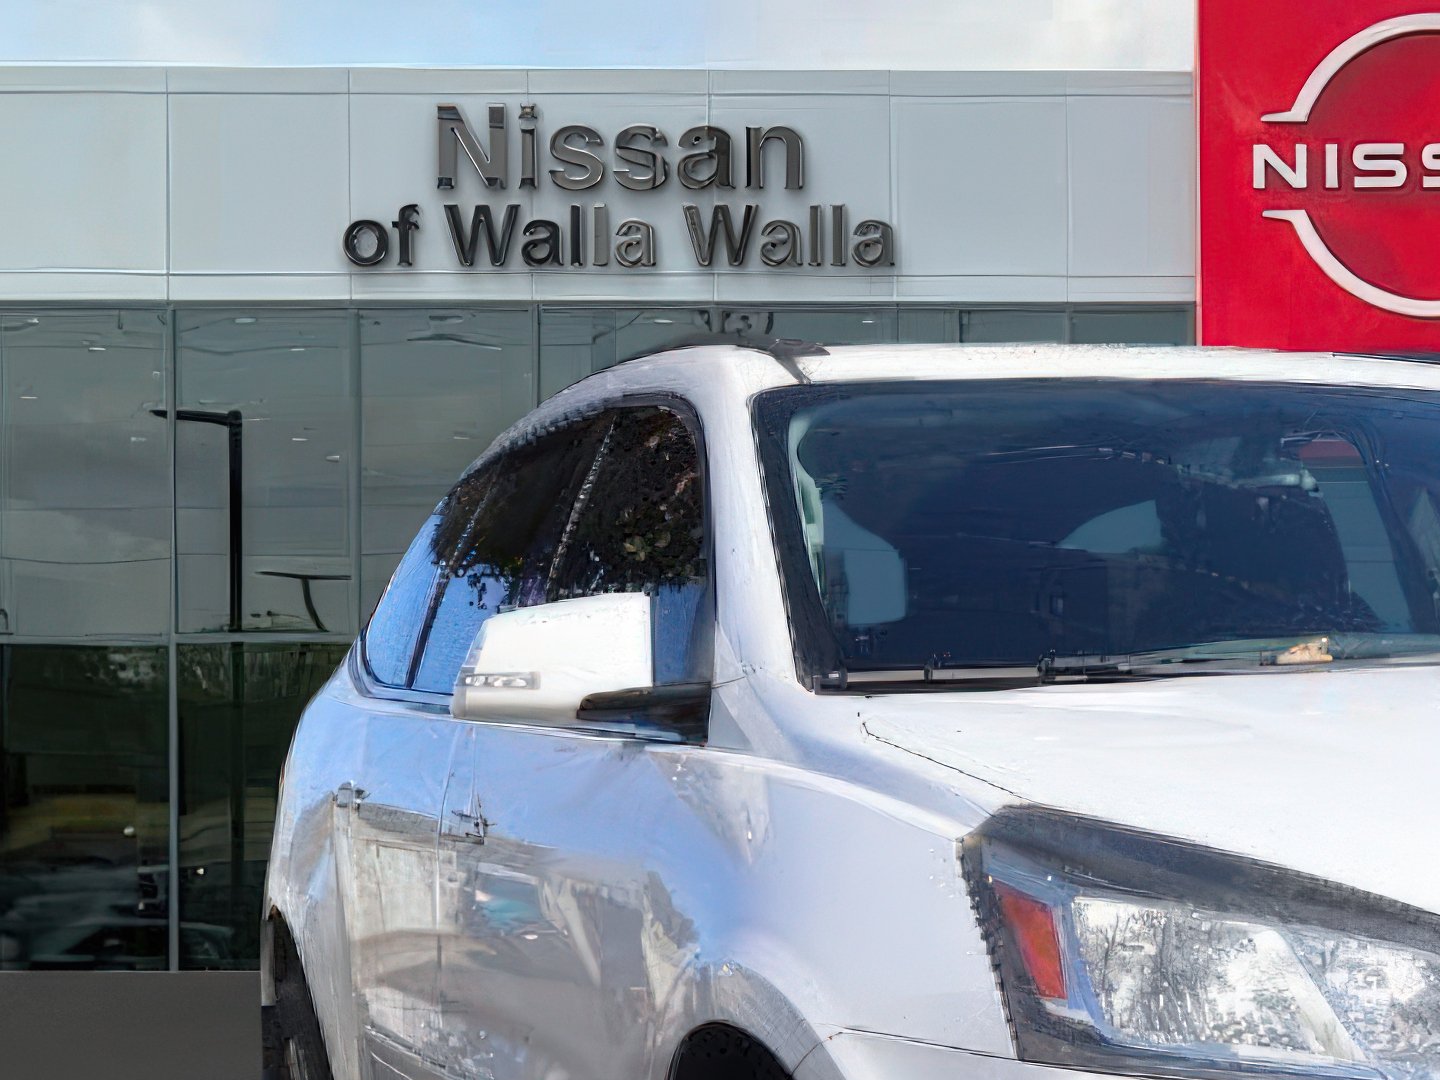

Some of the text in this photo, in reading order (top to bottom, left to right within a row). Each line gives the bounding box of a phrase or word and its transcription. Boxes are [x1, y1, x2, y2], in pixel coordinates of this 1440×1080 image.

[436, 102, 805, 191] Nissan
[341, 203, 896, 267] of Walla Walla
